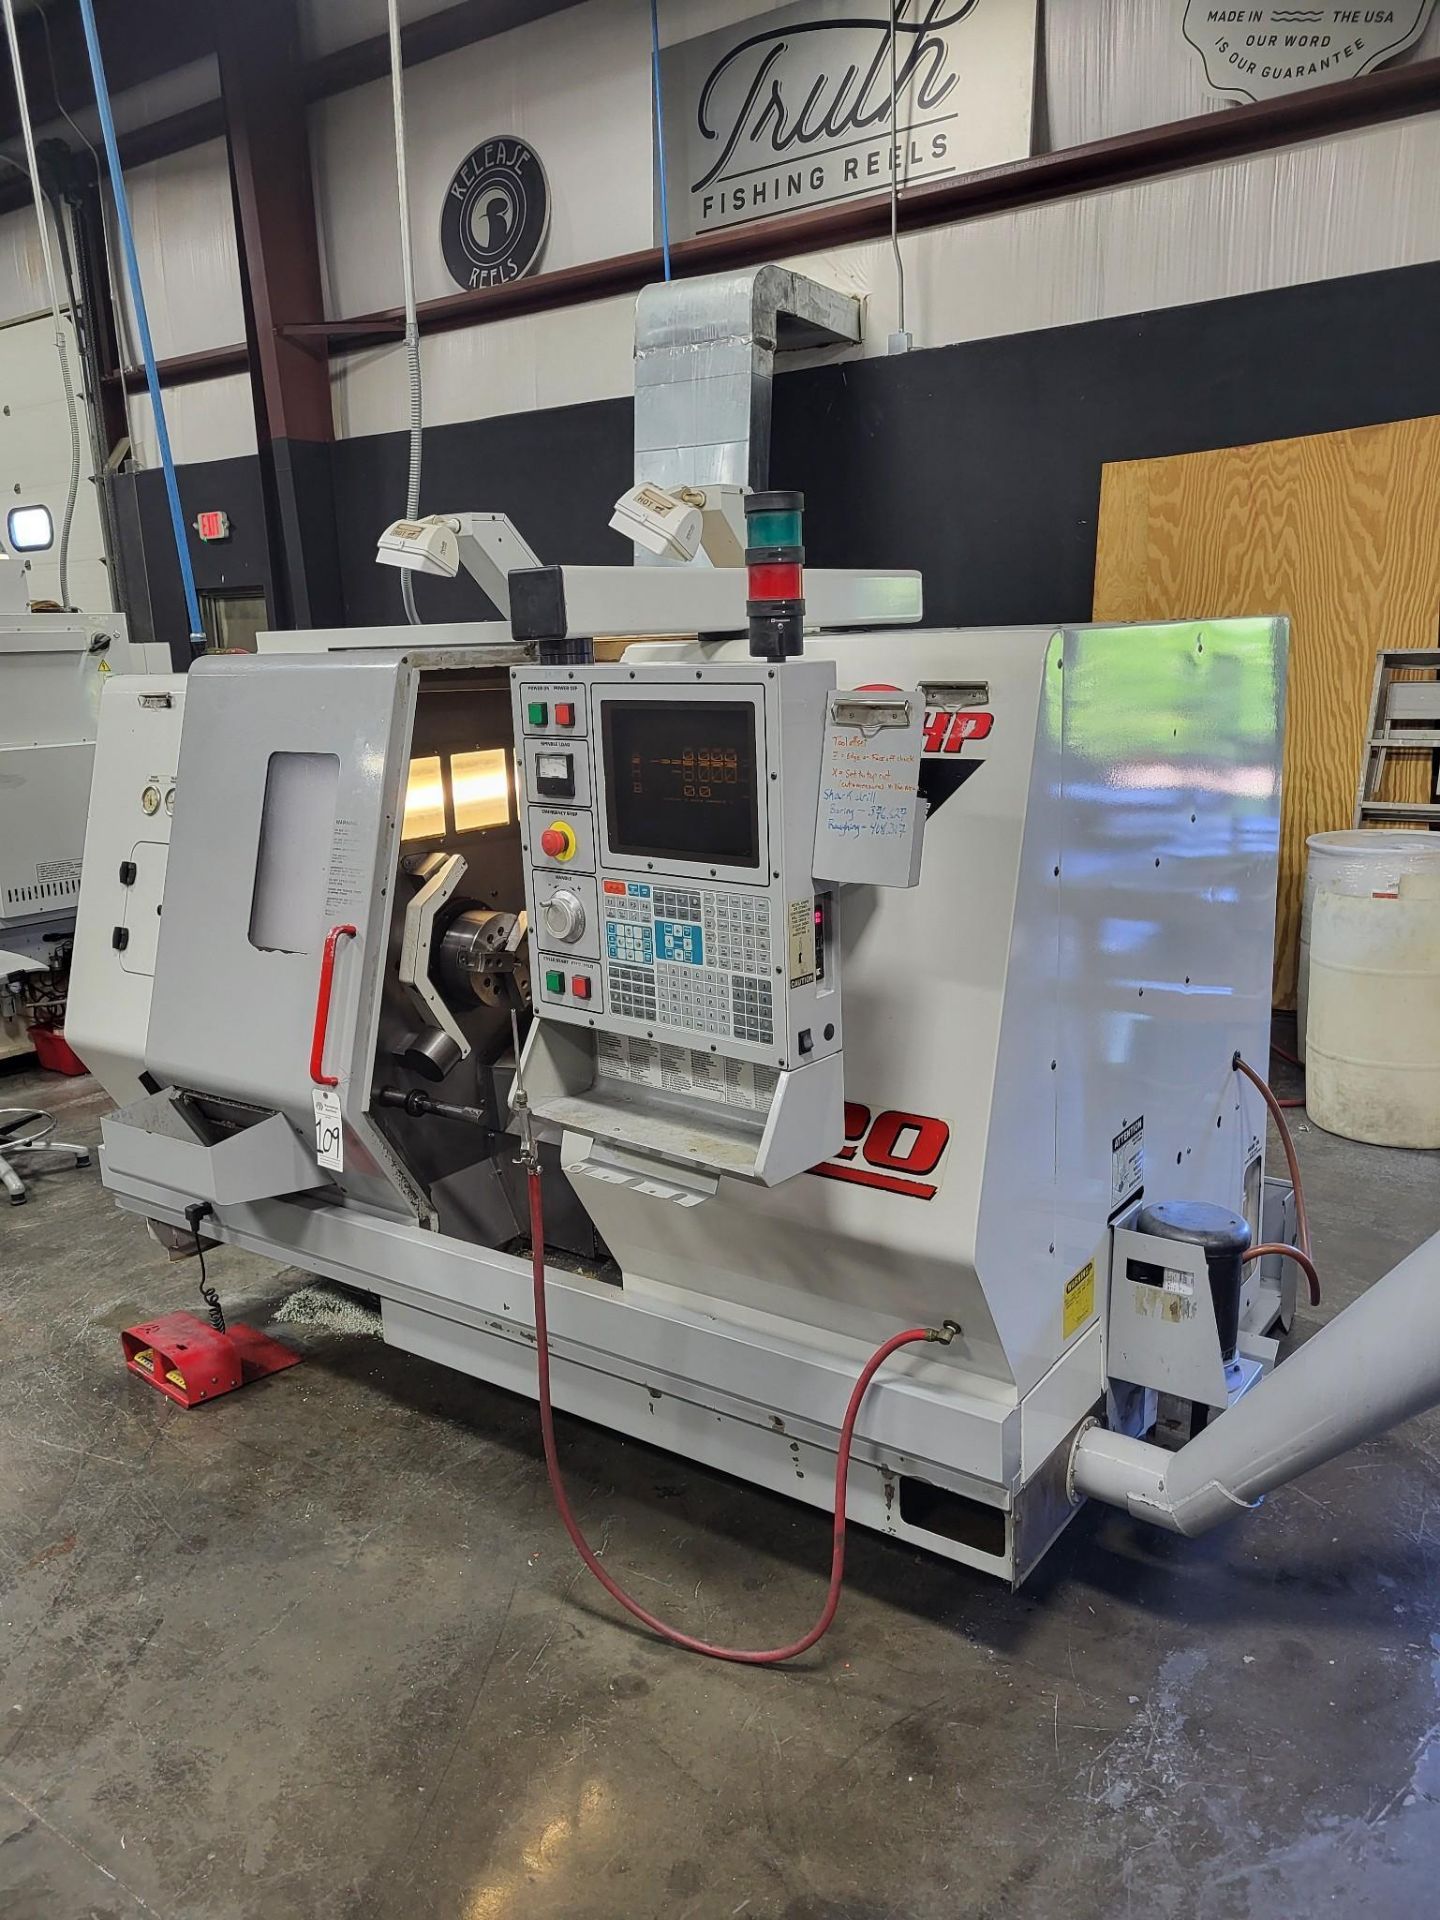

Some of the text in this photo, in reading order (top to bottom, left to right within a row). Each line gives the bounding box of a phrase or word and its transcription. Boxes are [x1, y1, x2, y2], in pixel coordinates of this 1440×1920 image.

[1207, 10, 1394, 23] MADE IN THE USA
[1246, 35, 1331, 48] OUR WORD
[1215, 36, 1365, 79] IS OUR GUARANTEE
[691, 0, 980, 193] Truth
[451, 141, 530, 201] RELEASE
[703, 134, 947, 218] FISHING REELS
[468, 258, 518, 289] REELS
[637, 496, 653, 507] HOT
[201, 513, 220, 537] EXIT
[832, 736, 848, 747] Tool
[316, 1118, 340, 1159] 109
[1114, 1118, 1143, 1150] ATTENTION
